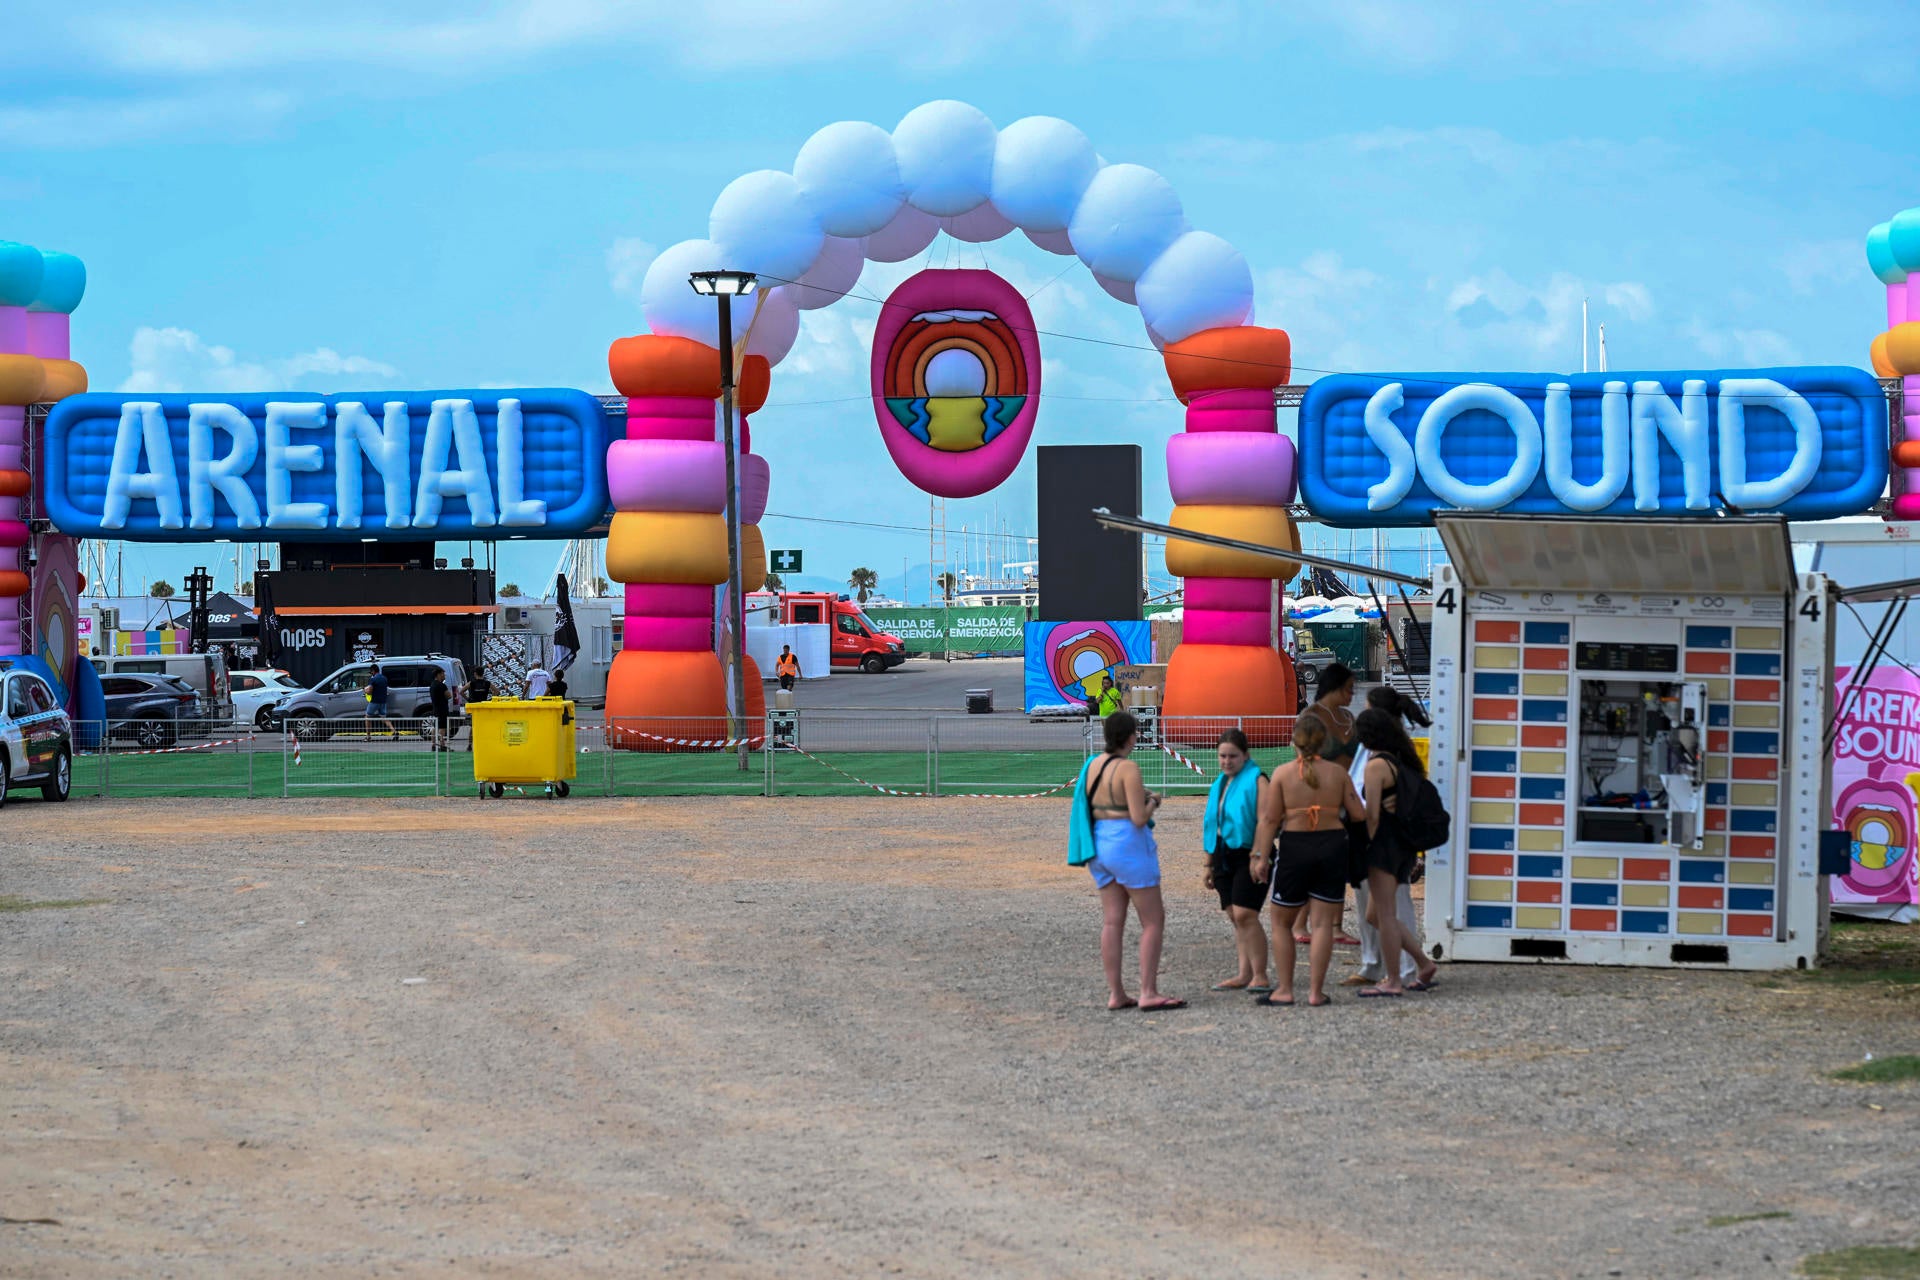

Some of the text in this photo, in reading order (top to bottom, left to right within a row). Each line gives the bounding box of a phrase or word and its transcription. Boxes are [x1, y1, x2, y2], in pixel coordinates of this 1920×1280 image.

[1364, 379, 1822, 512] SOUND
[101, 399, 547, 529] ARENAL
[1436, 588, 1457, 614] 4
[1800, 596, 1820, 622] 4
[877, 619, 935, 629] SALIDA DE
[880, 628, 943, 639] ERGENCIA
[950, 627, 1023, 638] EMERGENCIA
[957, 618, 1015, 628] SALIDA DE
[281, 628, 326, 651] nipes
[1839, 724, 1920, 764] SOUN
